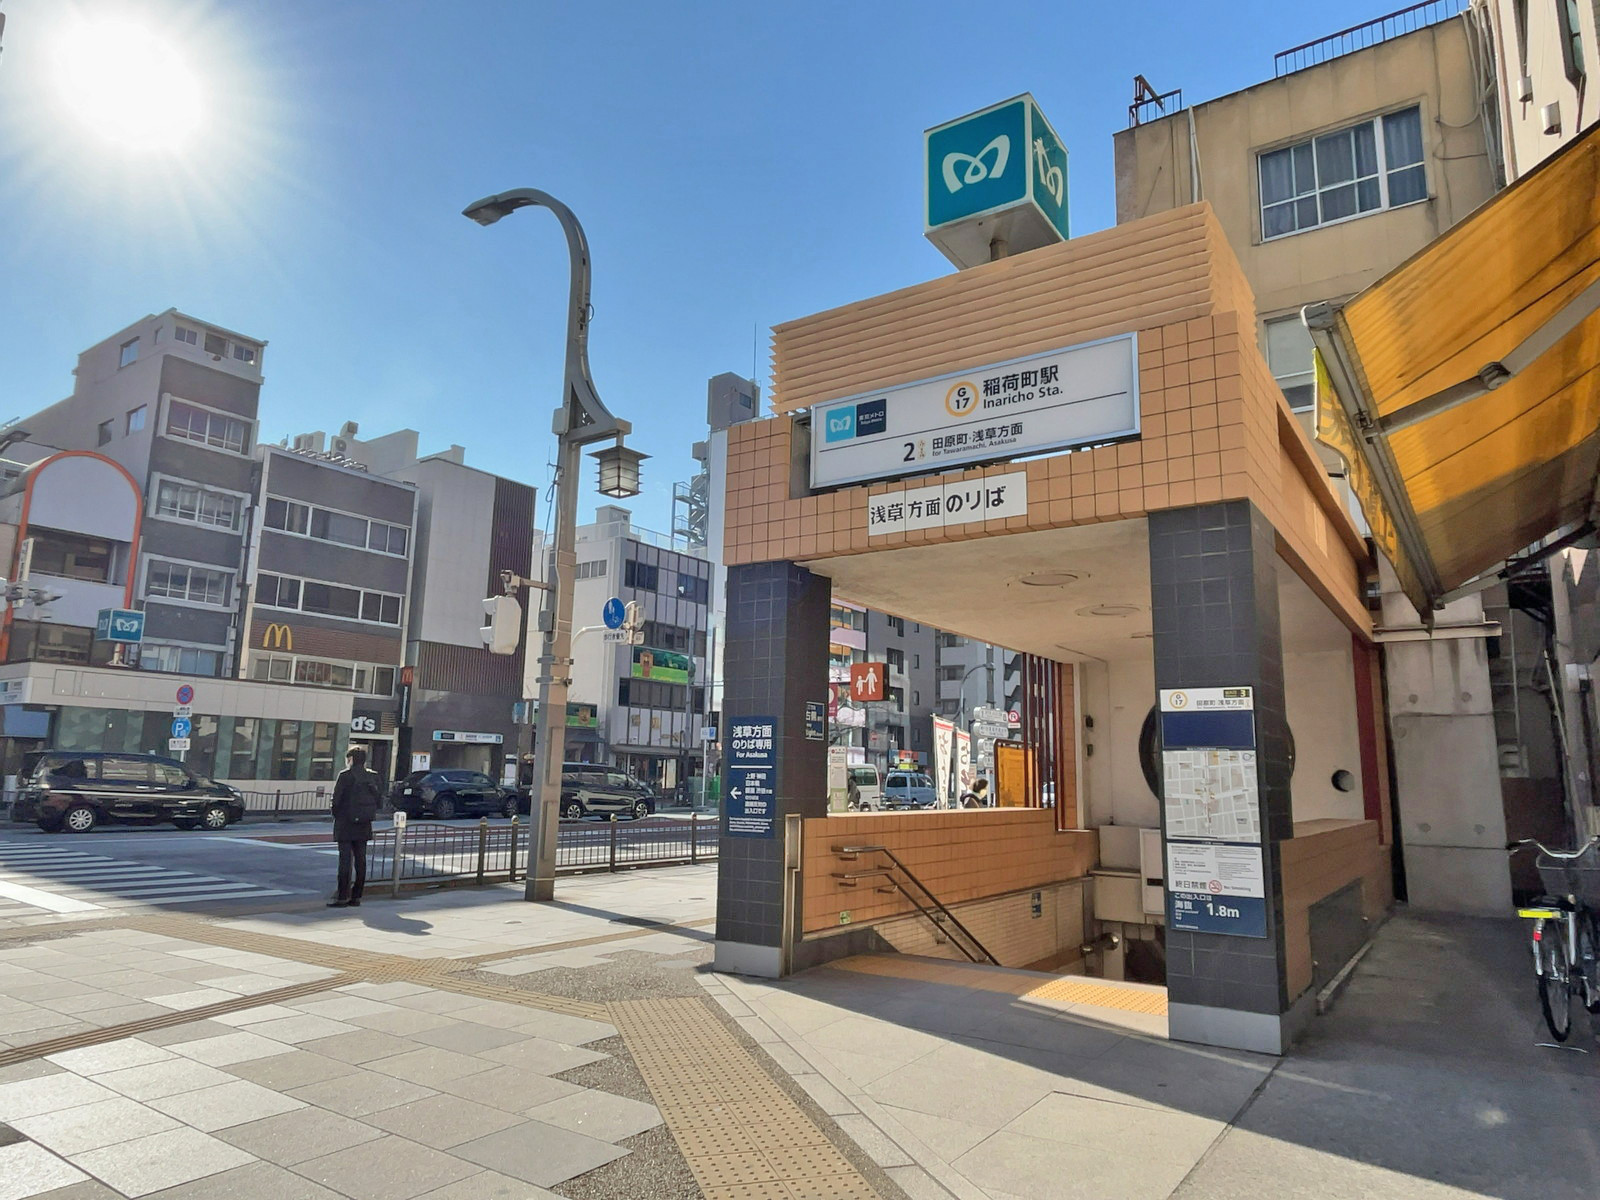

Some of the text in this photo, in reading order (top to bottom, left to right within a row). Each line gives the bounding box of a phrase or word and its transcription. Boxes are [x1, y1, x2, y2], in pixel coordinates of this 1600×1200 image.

[983, 365, 1059, 397] 稲荷町駅
[957, 388, 967, 397] G
[983, 386, 1063, 409] Inaricho Sta.
[955, 398, 970, 409] 17
[903, 442, 915, 462] 2
[943, 442, 987, 455] Tawaramachi,
[988, 437, 1017, 447] Asakusa
[732, 725, 772, 738] 浅草方面
[732, 739, 772, 750] のりば専用
[1206, 903, 1240, 918] 1.8m
